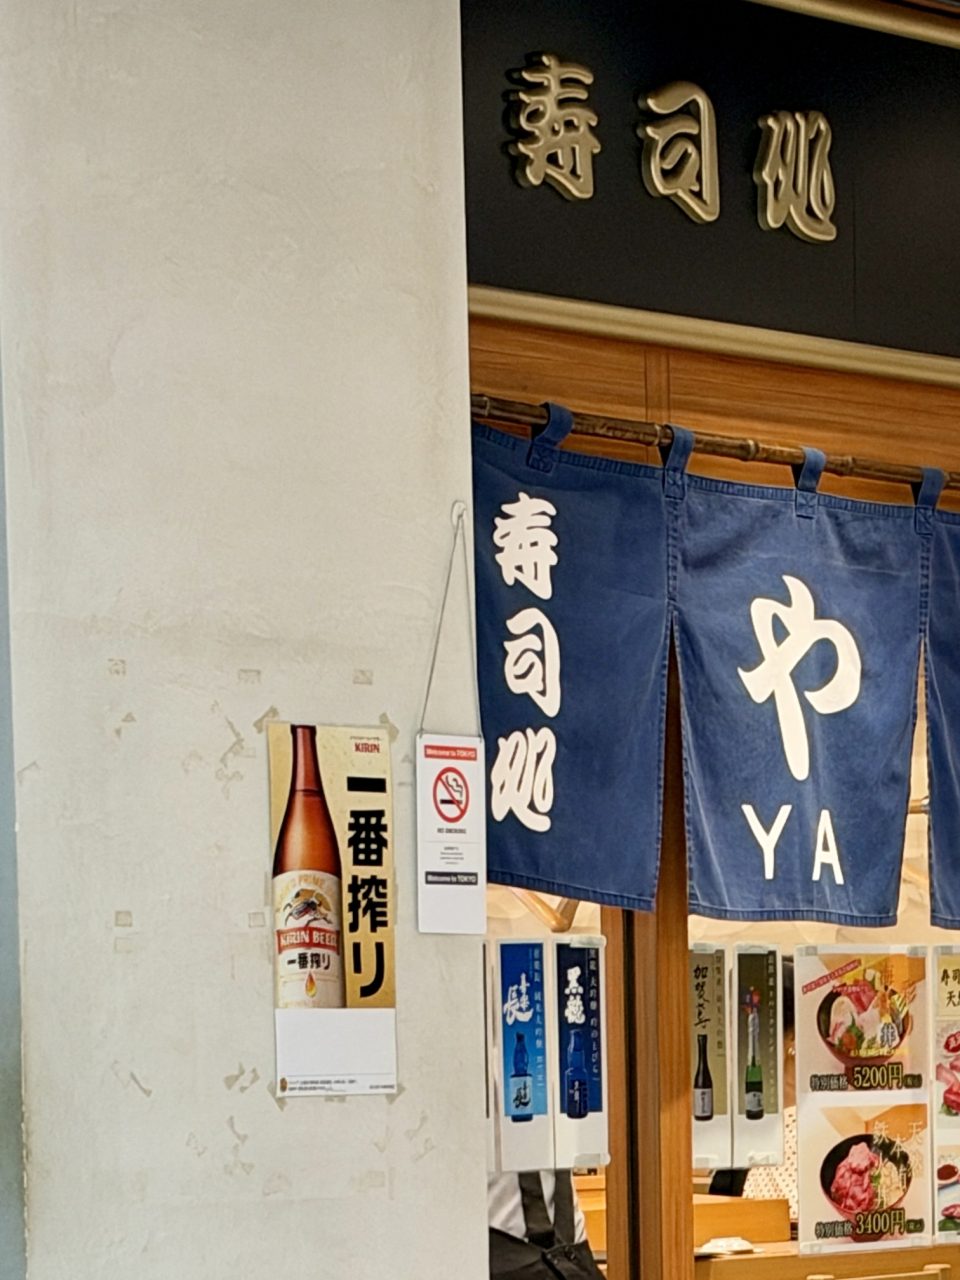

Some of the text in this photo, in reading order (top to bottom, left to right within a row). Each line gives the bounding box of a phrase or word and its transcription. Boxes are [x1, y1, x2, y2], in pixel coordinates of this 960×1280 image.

[511, 52, 837, 243] 寿司処
[492, 491, 562, 833] 寿司処
[354, 742, 381, 754] KIRIN
[456, 749, 477, 758] TOKYO
[740, 802, 845, 886] YA
[346, 775, 390, 999] 一番搾り
[457, 875, 477, 883] TOKYO
[280, 930, 310, 946] KIRIN
[287, 952, 332, 970] 一番搾り
[853, 1062, 903, 1090] 5200円
[855, 1207, 906, 1236] 3400円
